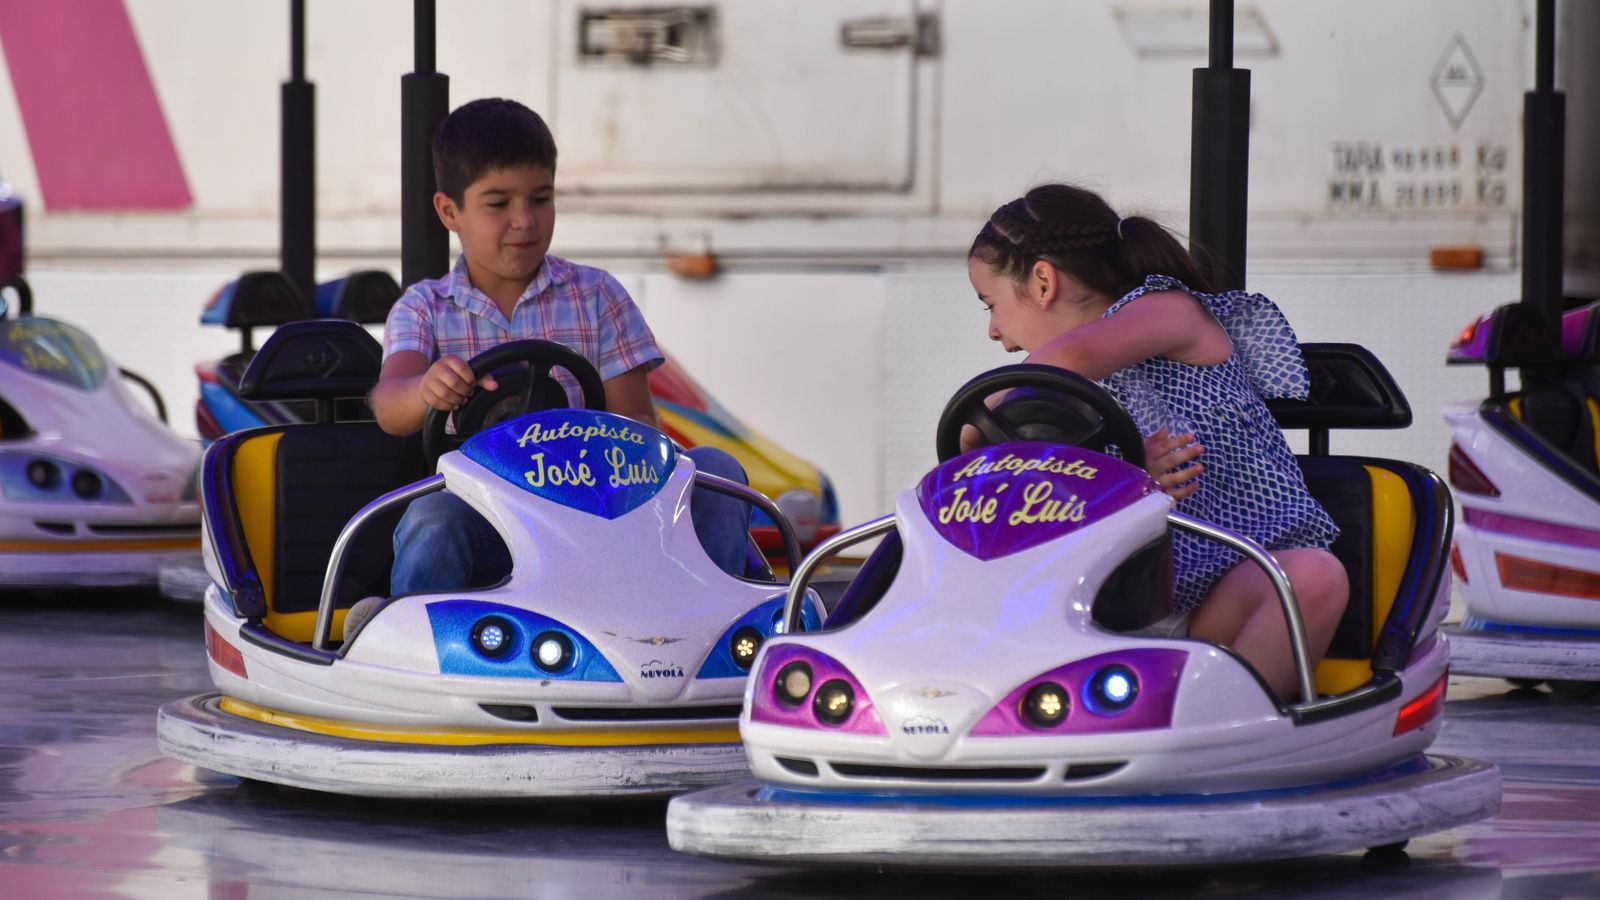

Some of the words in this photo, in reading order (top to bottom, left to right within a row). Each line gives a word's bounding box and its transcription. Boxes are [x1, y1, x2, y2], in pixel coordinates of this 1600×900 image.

[516, 421, 645, 448] Autopista
[524, 449, 597, 488] José
[604, 446, 660, 488] Luis
[952, 454, 1099, 482] Autopista
[939, 483, 1009, 525] José
[1008, 481, 1087, 526] Luis
[640, 668, 684, 678] NUVOLA
